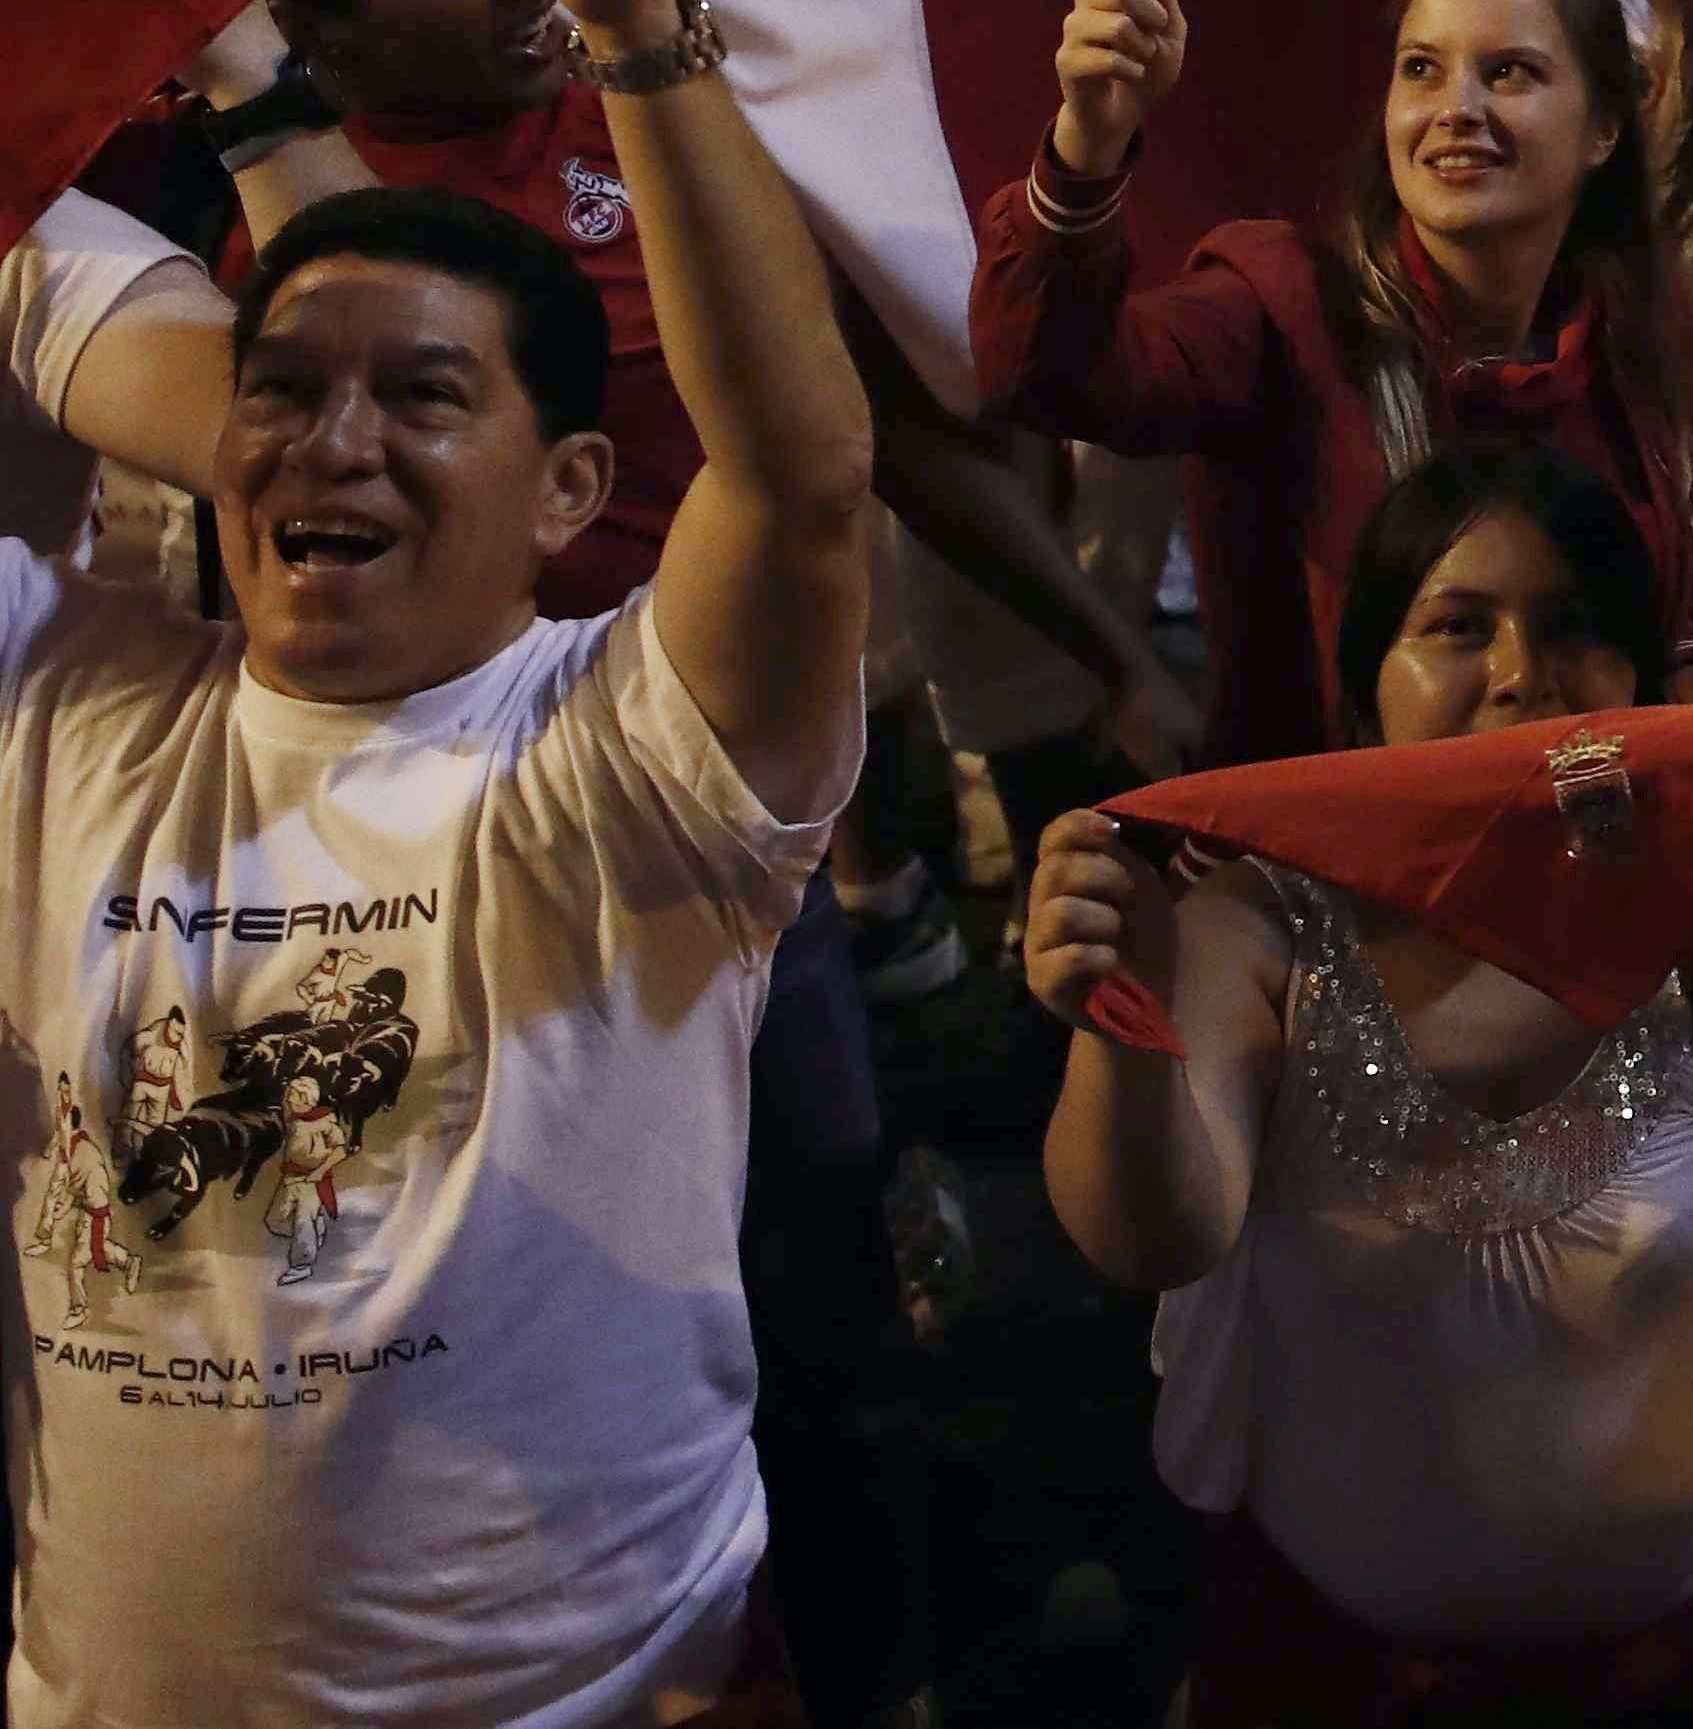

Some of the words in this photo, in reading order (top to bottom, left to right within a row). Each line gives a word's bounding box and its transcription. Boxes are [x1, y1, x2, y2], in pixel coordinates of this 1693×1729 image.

[34, 1334, 258, 1384] PAMPLONA
[299, 1332, 449, 1378] IRUÑA
[120, 1385, 143, 1405] 6
[231, 1388, 323, 1410] JULIO
